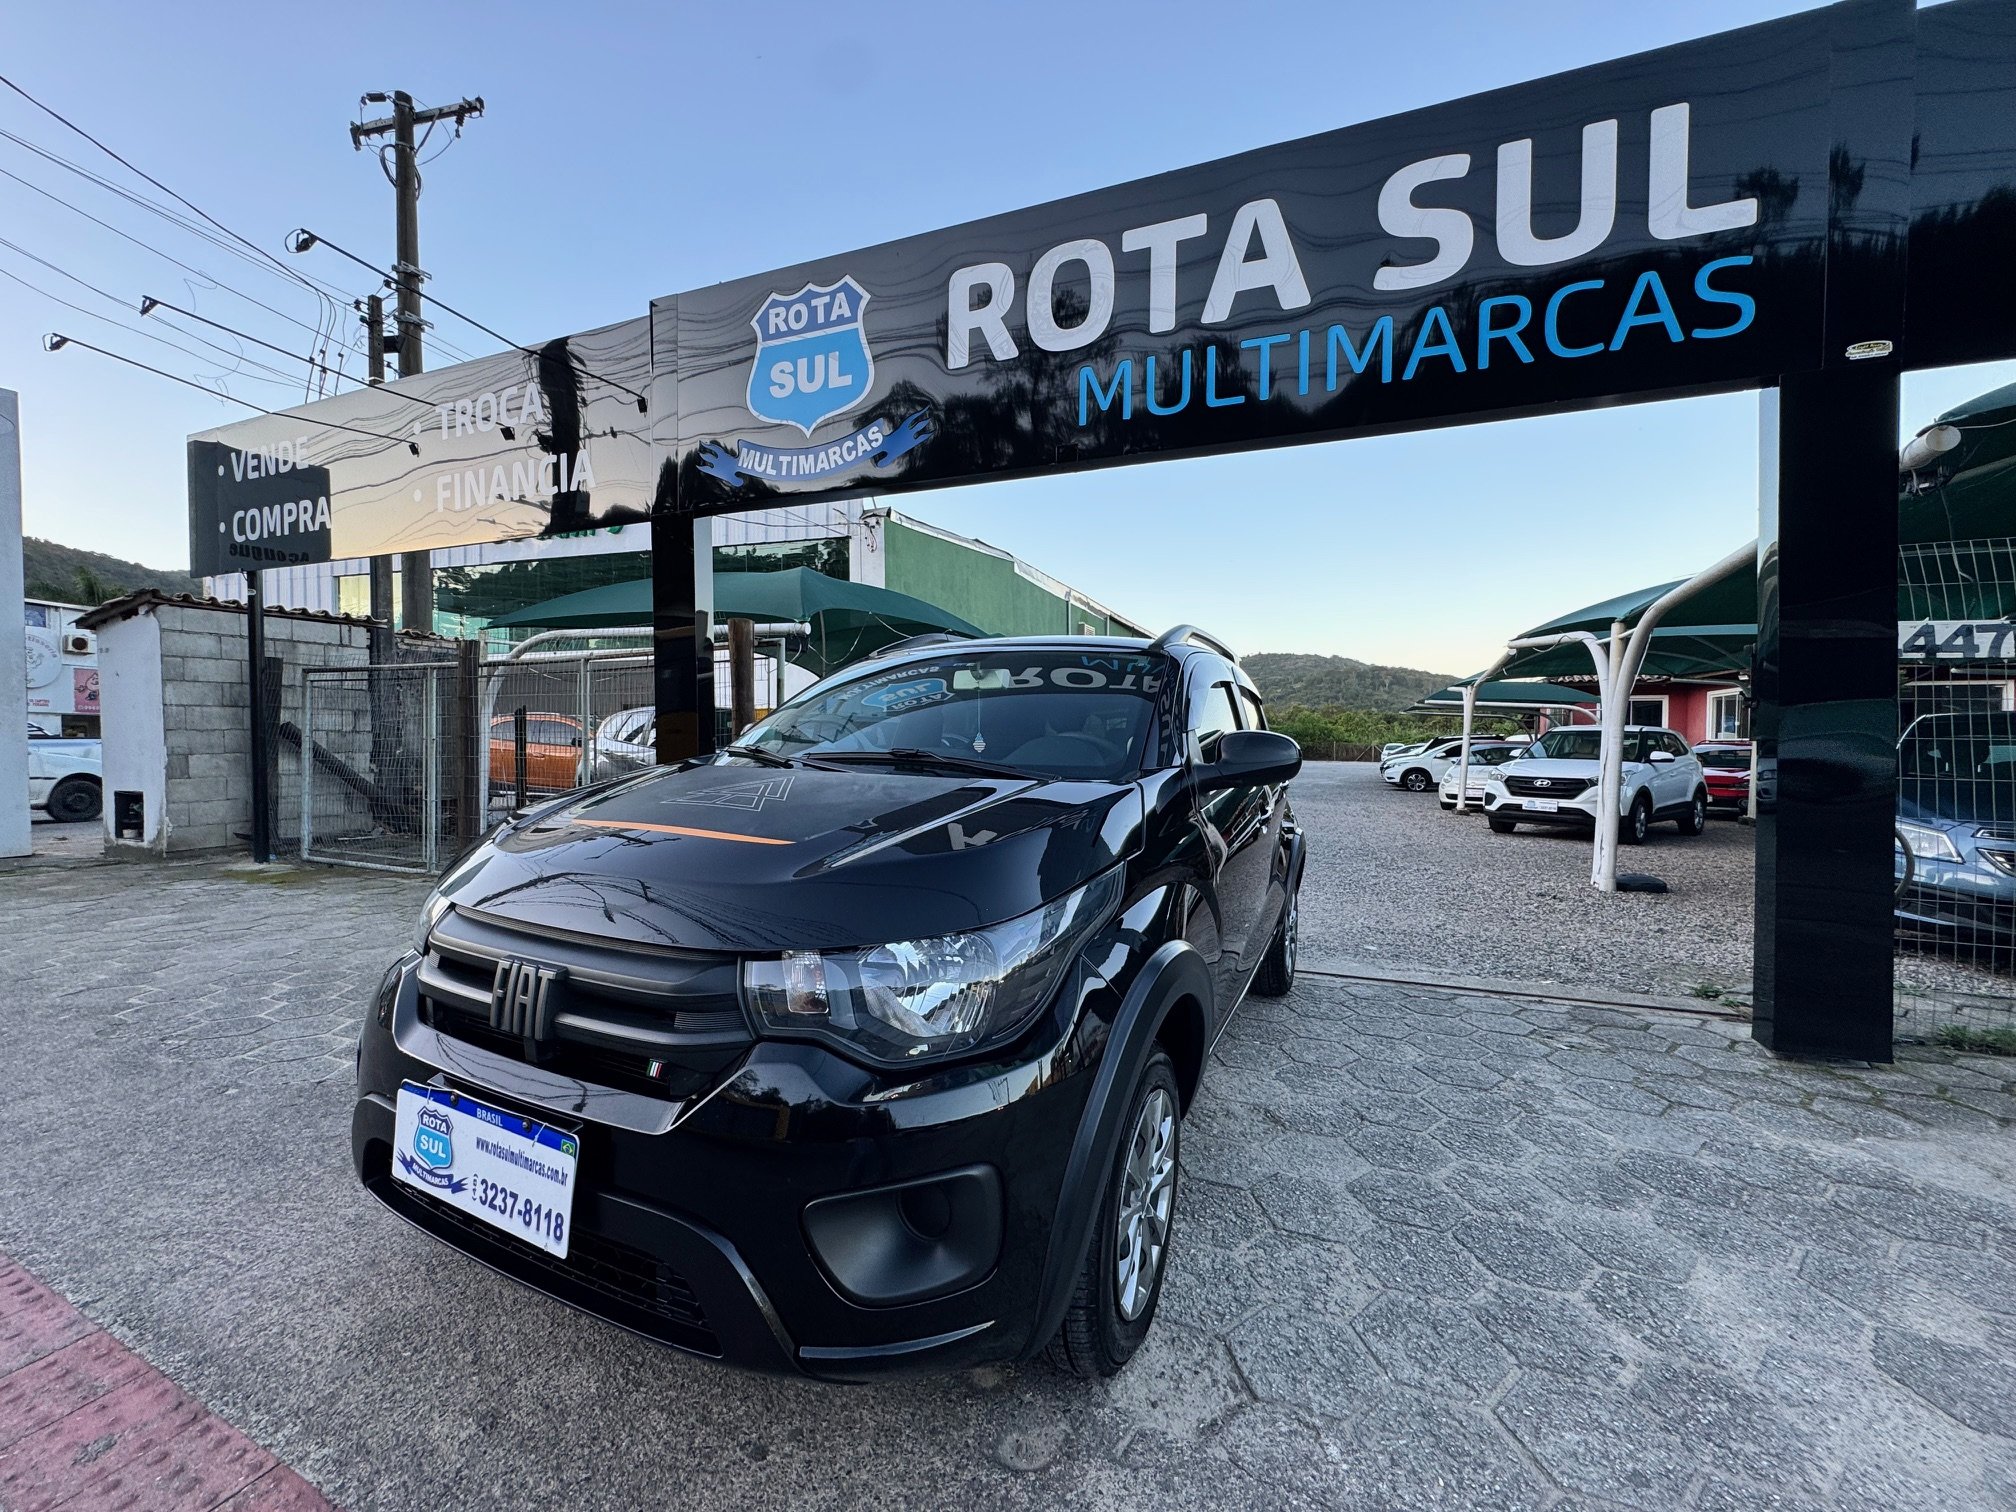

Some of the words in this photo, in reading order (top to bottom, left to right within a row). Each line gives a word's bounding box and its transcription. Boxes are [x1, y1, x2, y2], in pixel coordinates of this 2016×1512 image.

[947, 199, 1311, 369] ROTA
[1373, 102, 1757, 290] SUL
[768, 292, 851, 334] ROTA
[1079, 255, 1756, 426] MULTIMARCAS
[769, 351, 852, 399] SUL
[435, 382, 544, 440] TROCA
[231, 435, 309, 482] VENDE
[738, 426, 883, 475] MULTIMARCAS
[437, 448, 596, 512] FINANCIA
[232, 496, 332, 543] COMPRA
[1898, 624, 2013, 658] 447
[489, 957, 559, 1042] FIAT
[422, 1114, 447, 1134] ROTA
[476, 1108, 503, 1127] BRASIL
[420, 1134, 446, 1158] SUL
[476, 1137, 568, 1186] www.rotasulmultimarcas.com.br
[412, 1161, 449, 1185] MULTIMARCAS
[479, 1178, 564, 1241] 3237-8118
